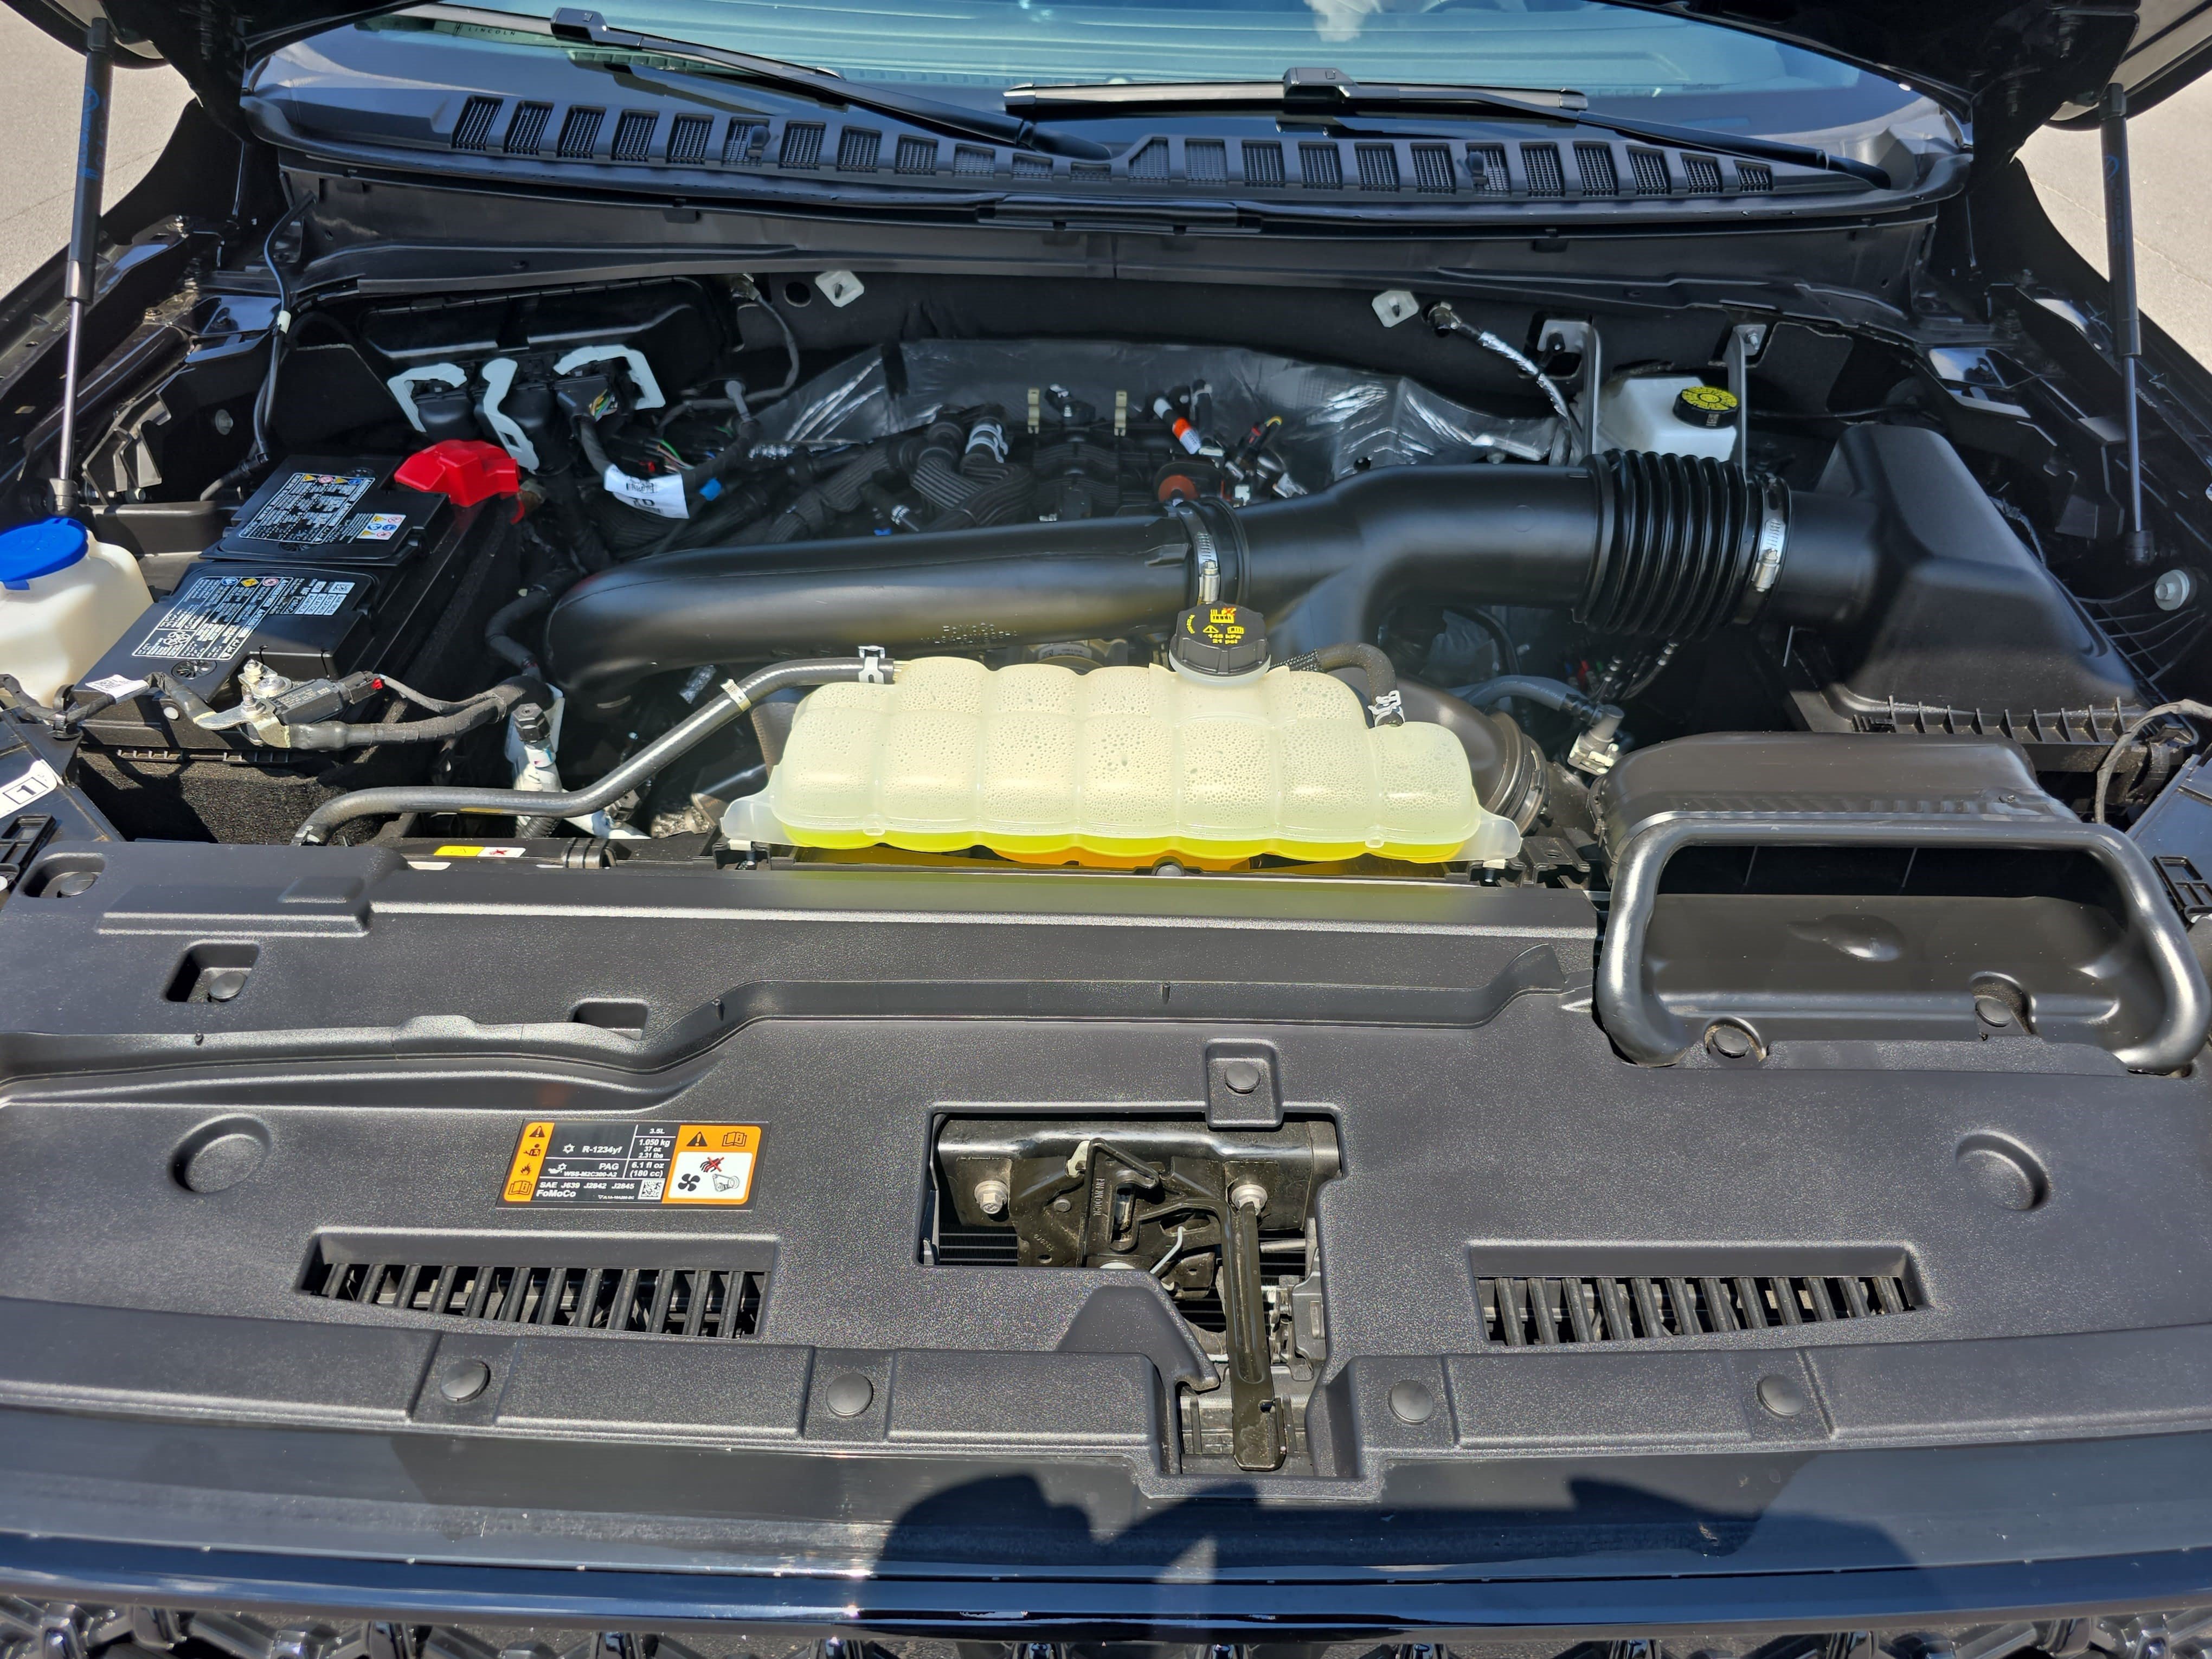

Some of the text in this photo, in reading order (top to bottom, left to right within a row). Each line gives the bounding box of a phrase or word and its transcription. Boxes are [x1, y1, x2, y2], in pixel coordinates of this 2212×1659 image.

[468, 27, 516, 36] LINCOLN
[660, 1139, 671, 1148] kg
[582, 1146, 623, 1155] R-1234yf
[629, 1169, 664, 1178] (180 cc)
